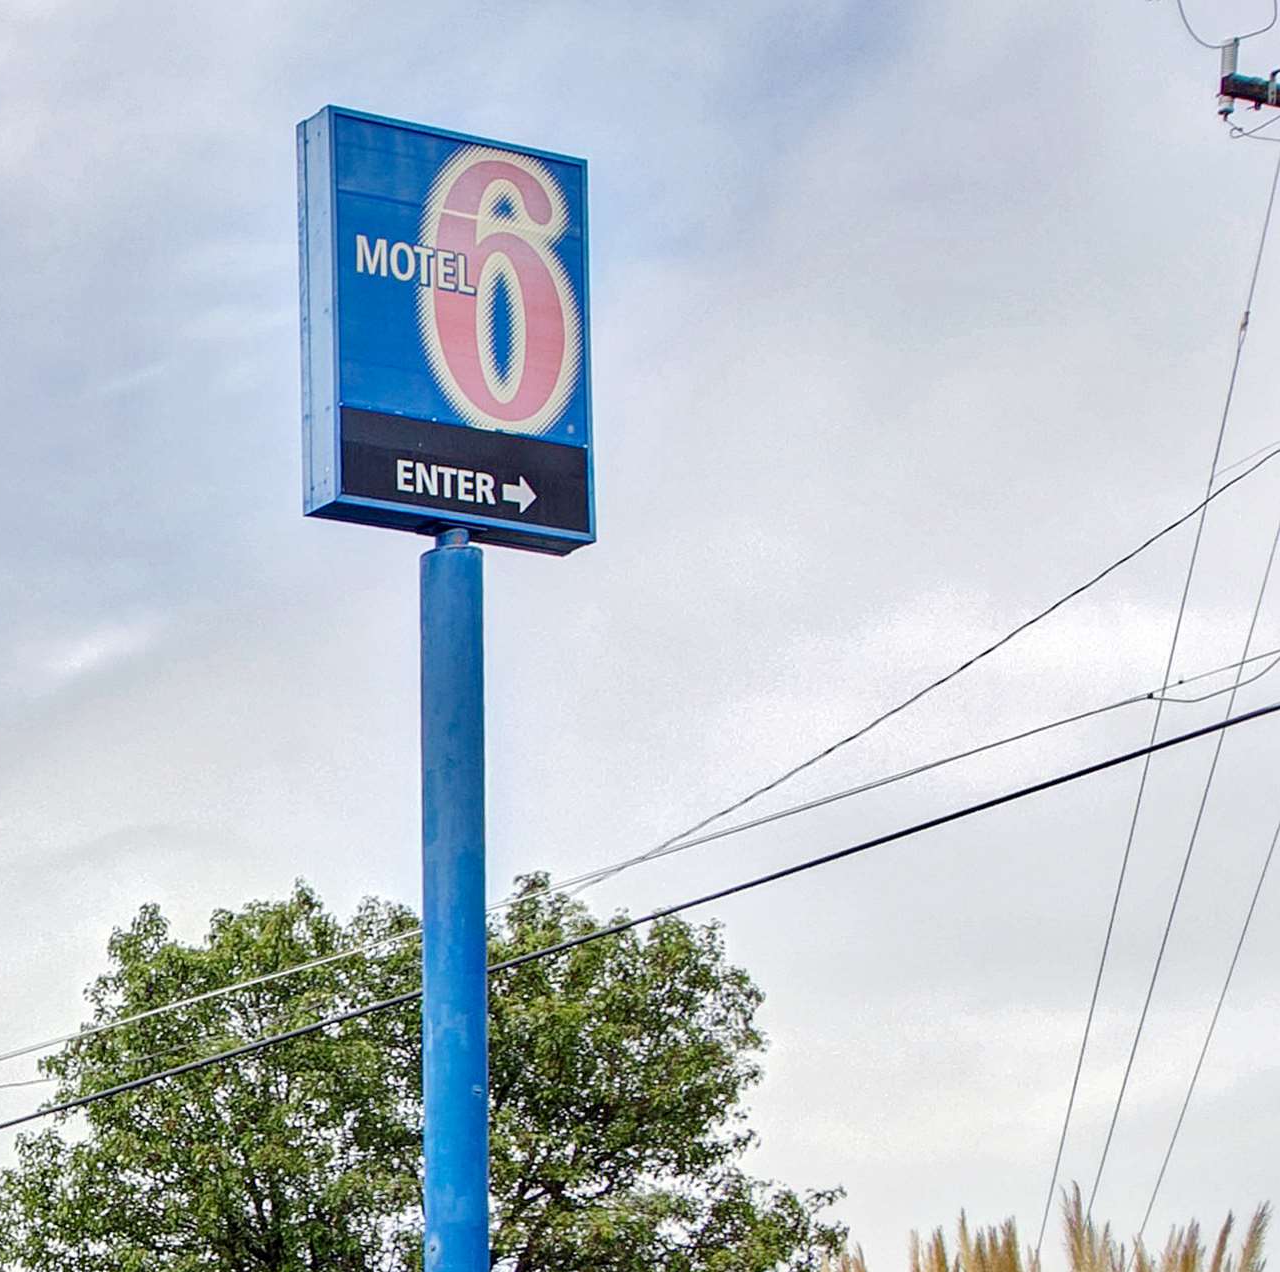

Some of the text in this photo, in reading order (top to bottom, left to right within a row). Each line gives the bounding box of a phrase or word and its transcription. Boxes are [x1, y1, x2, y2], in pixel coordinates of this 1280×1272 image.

[356, 150, 575, 431] MOTEL 6
[397, 459, 496, 505] ENTER
